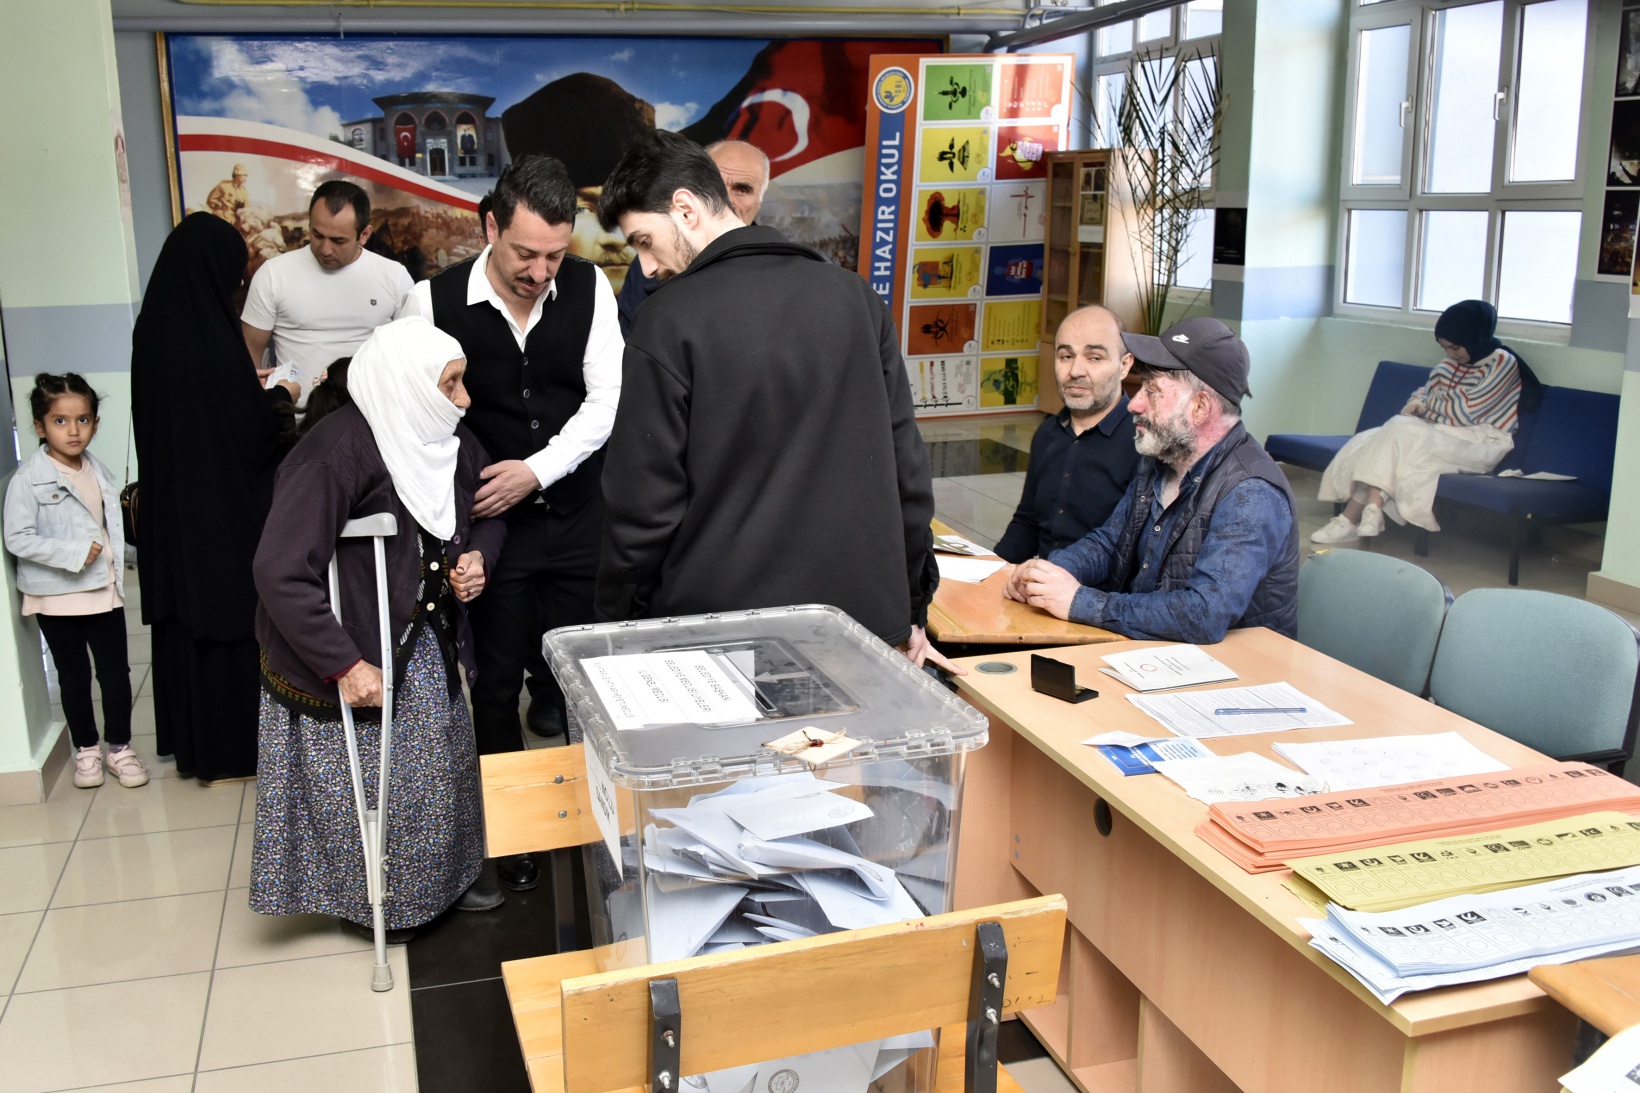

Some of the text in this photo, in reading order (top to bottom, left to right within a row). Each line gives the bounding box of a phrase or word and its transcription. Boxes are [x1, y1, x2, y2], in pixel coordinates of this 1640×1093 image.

[879, 131, 901, 198] OKUL
[873, 205, 896, 276] HAZIR
[872, 282, 890, 305] E
